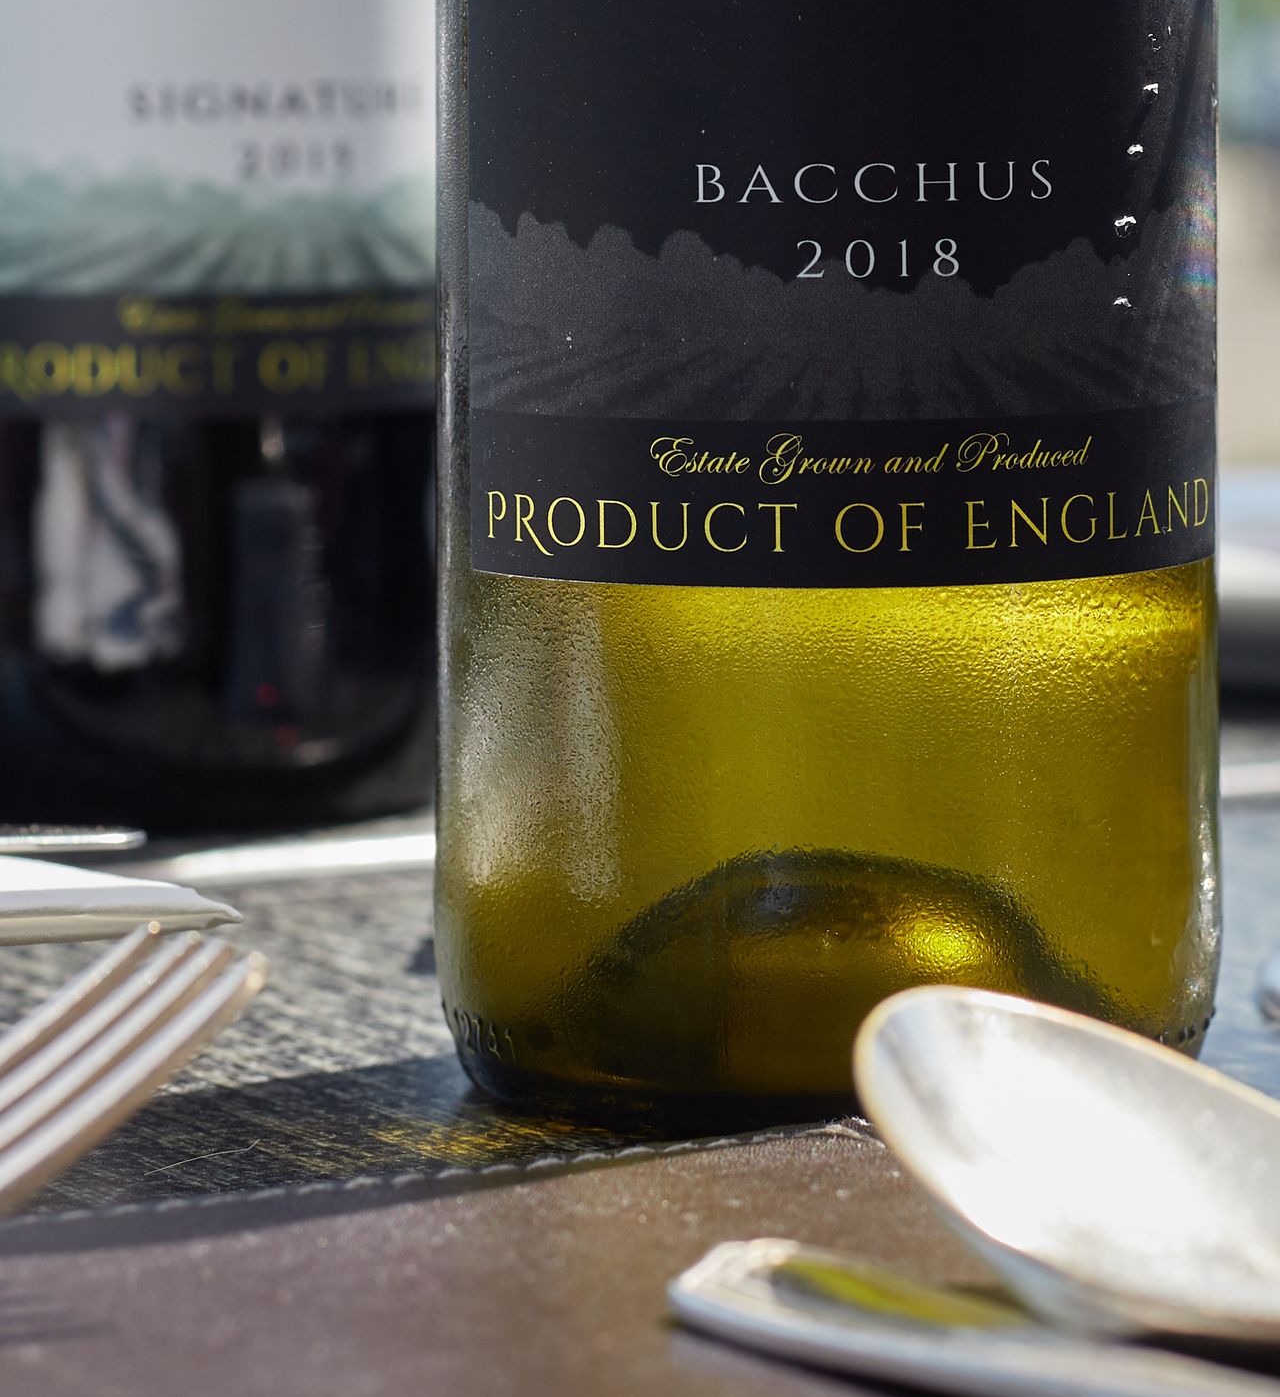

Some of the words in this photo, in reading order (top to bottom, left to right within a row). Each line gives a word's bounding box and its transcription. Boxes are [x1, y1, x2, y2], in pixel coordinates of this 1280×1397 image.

[694, 158, 1054, 204] BACCHUS
[795, 236, 961, 279] 2018
[648, 435, 750, 477] Estate
[758, 431, 877, 485] Grown
[883, 441, 949, 474] and
[954, 431, 1093, 473] Produced
[486, 489, 799, 557] PRODUCT
[834, 500, 926, 553] OF
[964, 476, 1210, 550] ENGLAND
